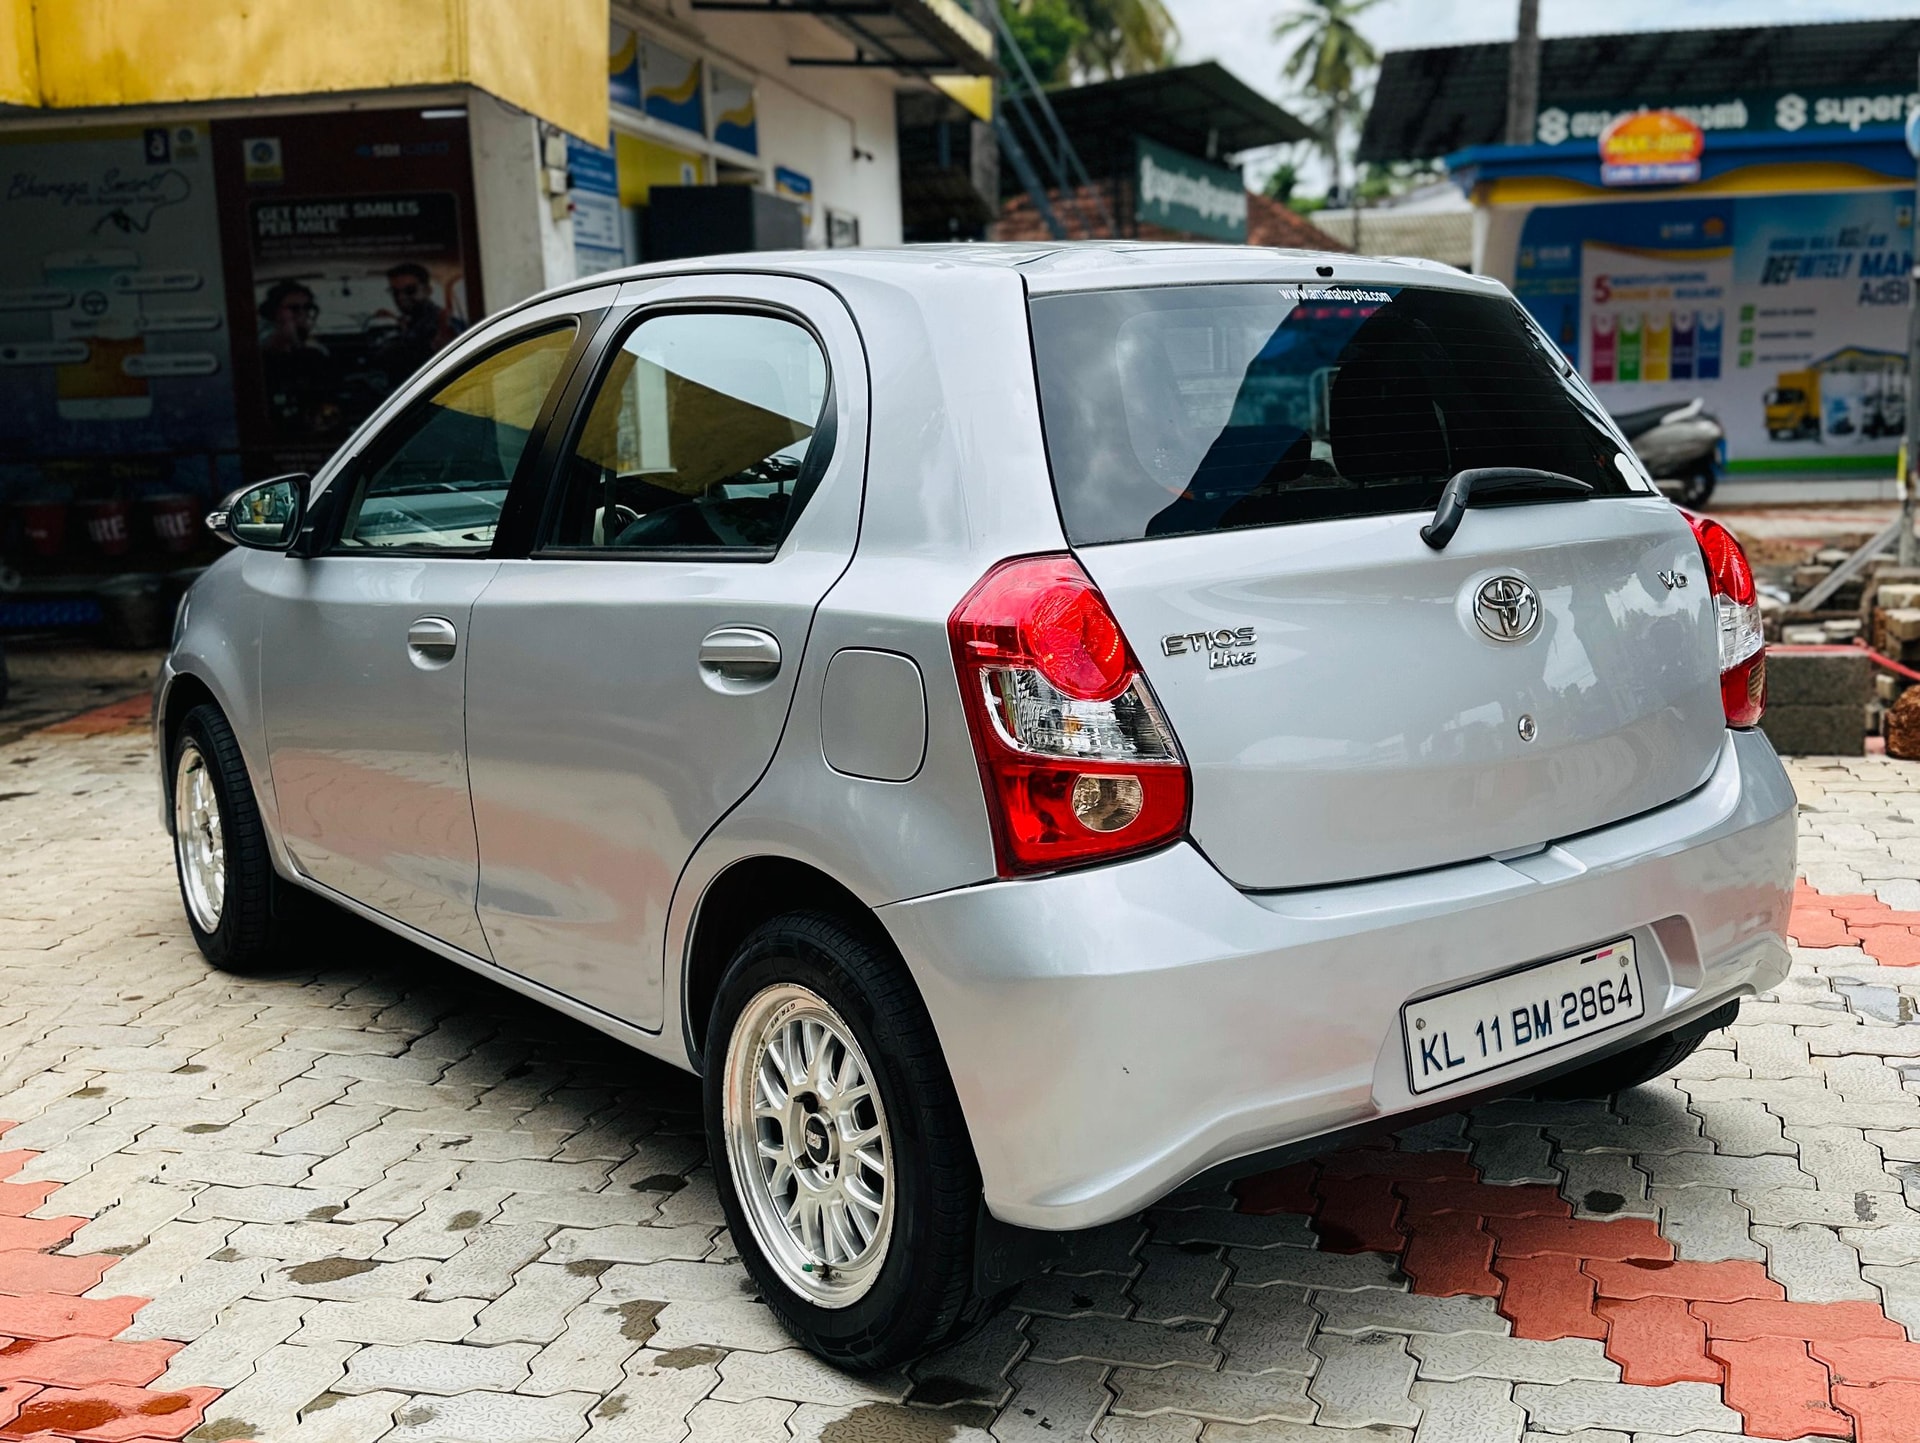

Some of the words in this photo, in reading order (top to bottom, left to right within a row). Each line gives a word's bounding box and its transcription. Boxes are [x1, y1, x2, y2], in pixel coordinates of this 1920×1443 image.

[257, 205, 292, 221] GET
[294, 202, 349, 219] MORE
[352, 200, 420, 218] SMILES
[258, 221, 291, 236] PER
[296, 219, 339, 235] MILE
[1278, 287, 1393, 304] www.amanatoyota.com
[1594, 273, 1610, 303] 5
[1161, 626, 1258, 657] ETIOS
[1209, 650, 1257, 670] Liva
[1420, 1031, 1466, 1076] KL
[1475, 1015, 1503, 1057] 11
[1511, 1000, 1553, 1047] BM
[1560, 972, 1633, 1030] 2864
